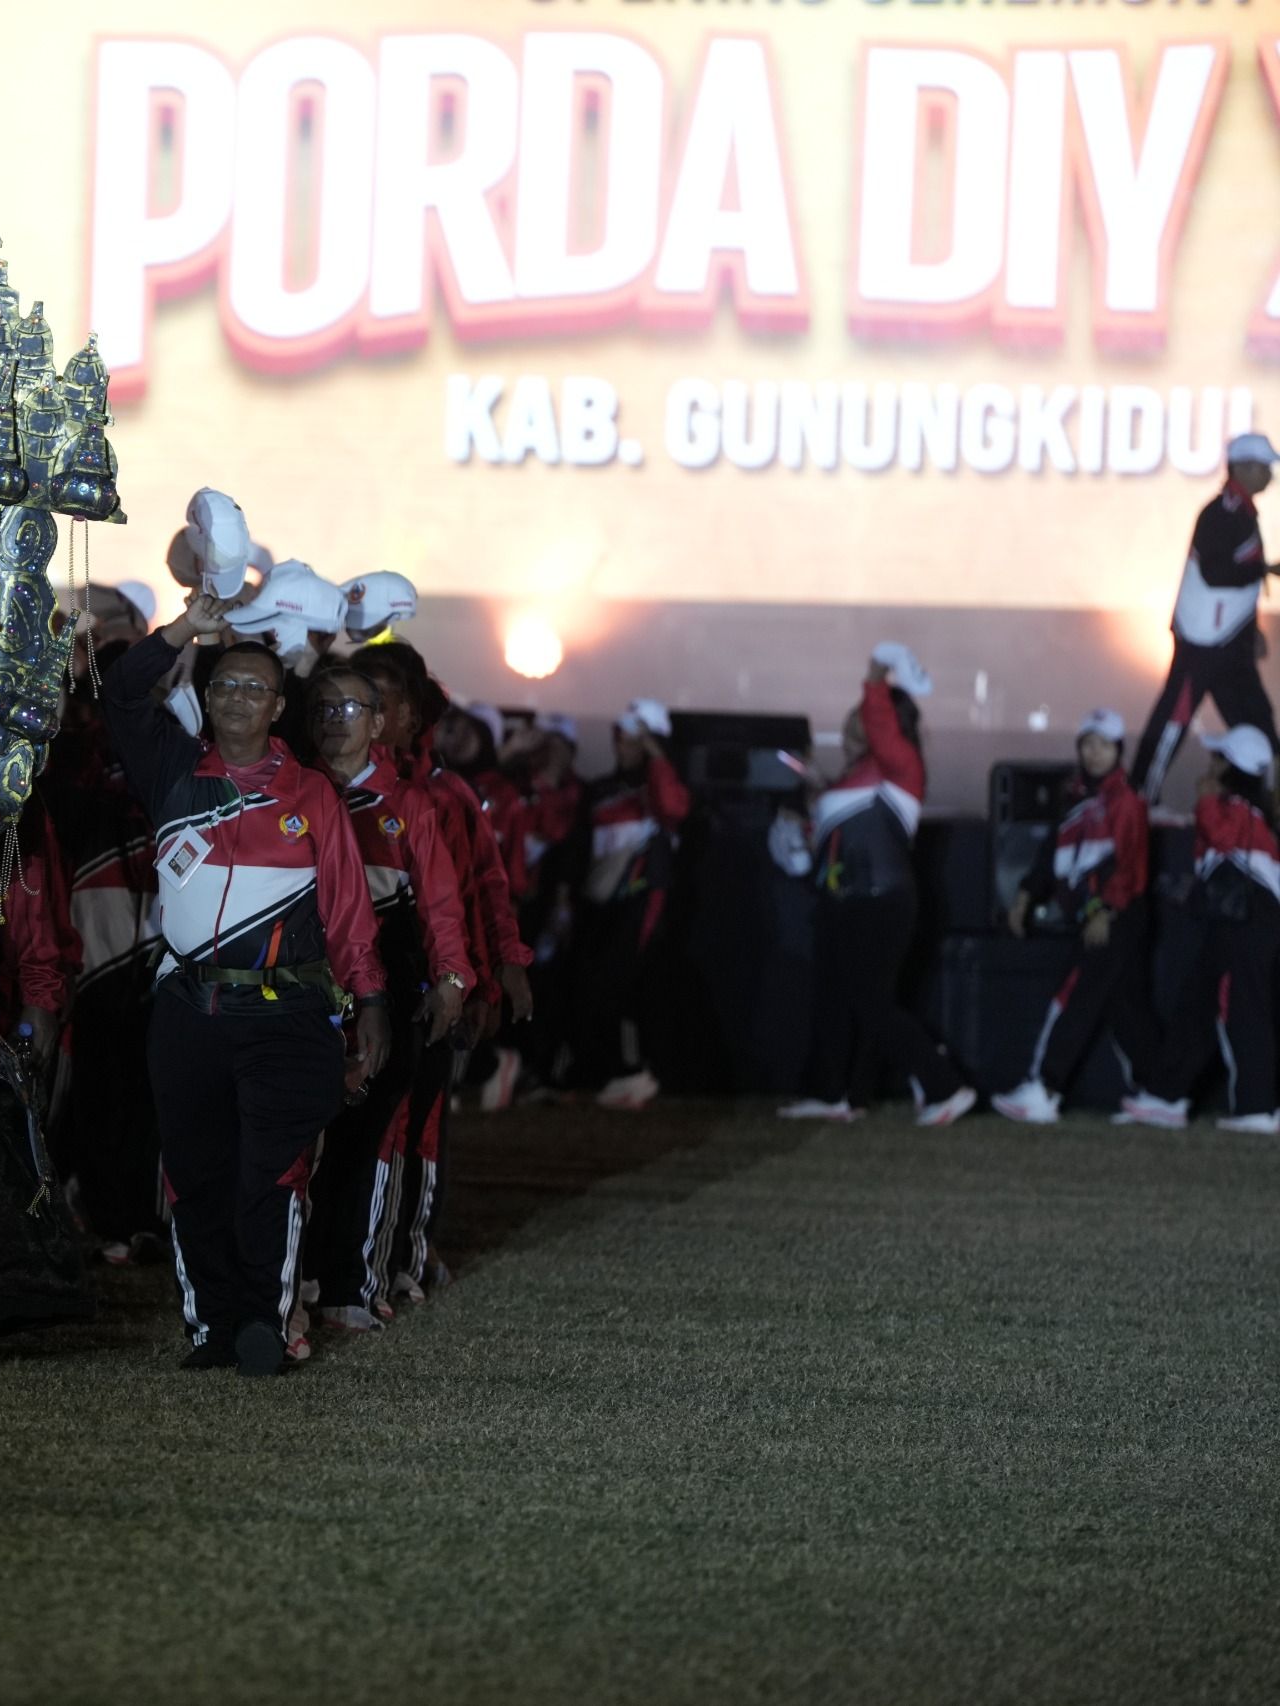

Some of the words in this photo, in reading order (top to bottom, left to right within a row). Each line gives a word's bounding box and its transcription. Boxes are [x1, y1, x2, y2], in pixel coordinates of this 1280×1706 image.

[89, 31, 806, 388] PORDA
[853, 42, 1219, 334] DIY
[444, 374, 643, 466] KAB.
